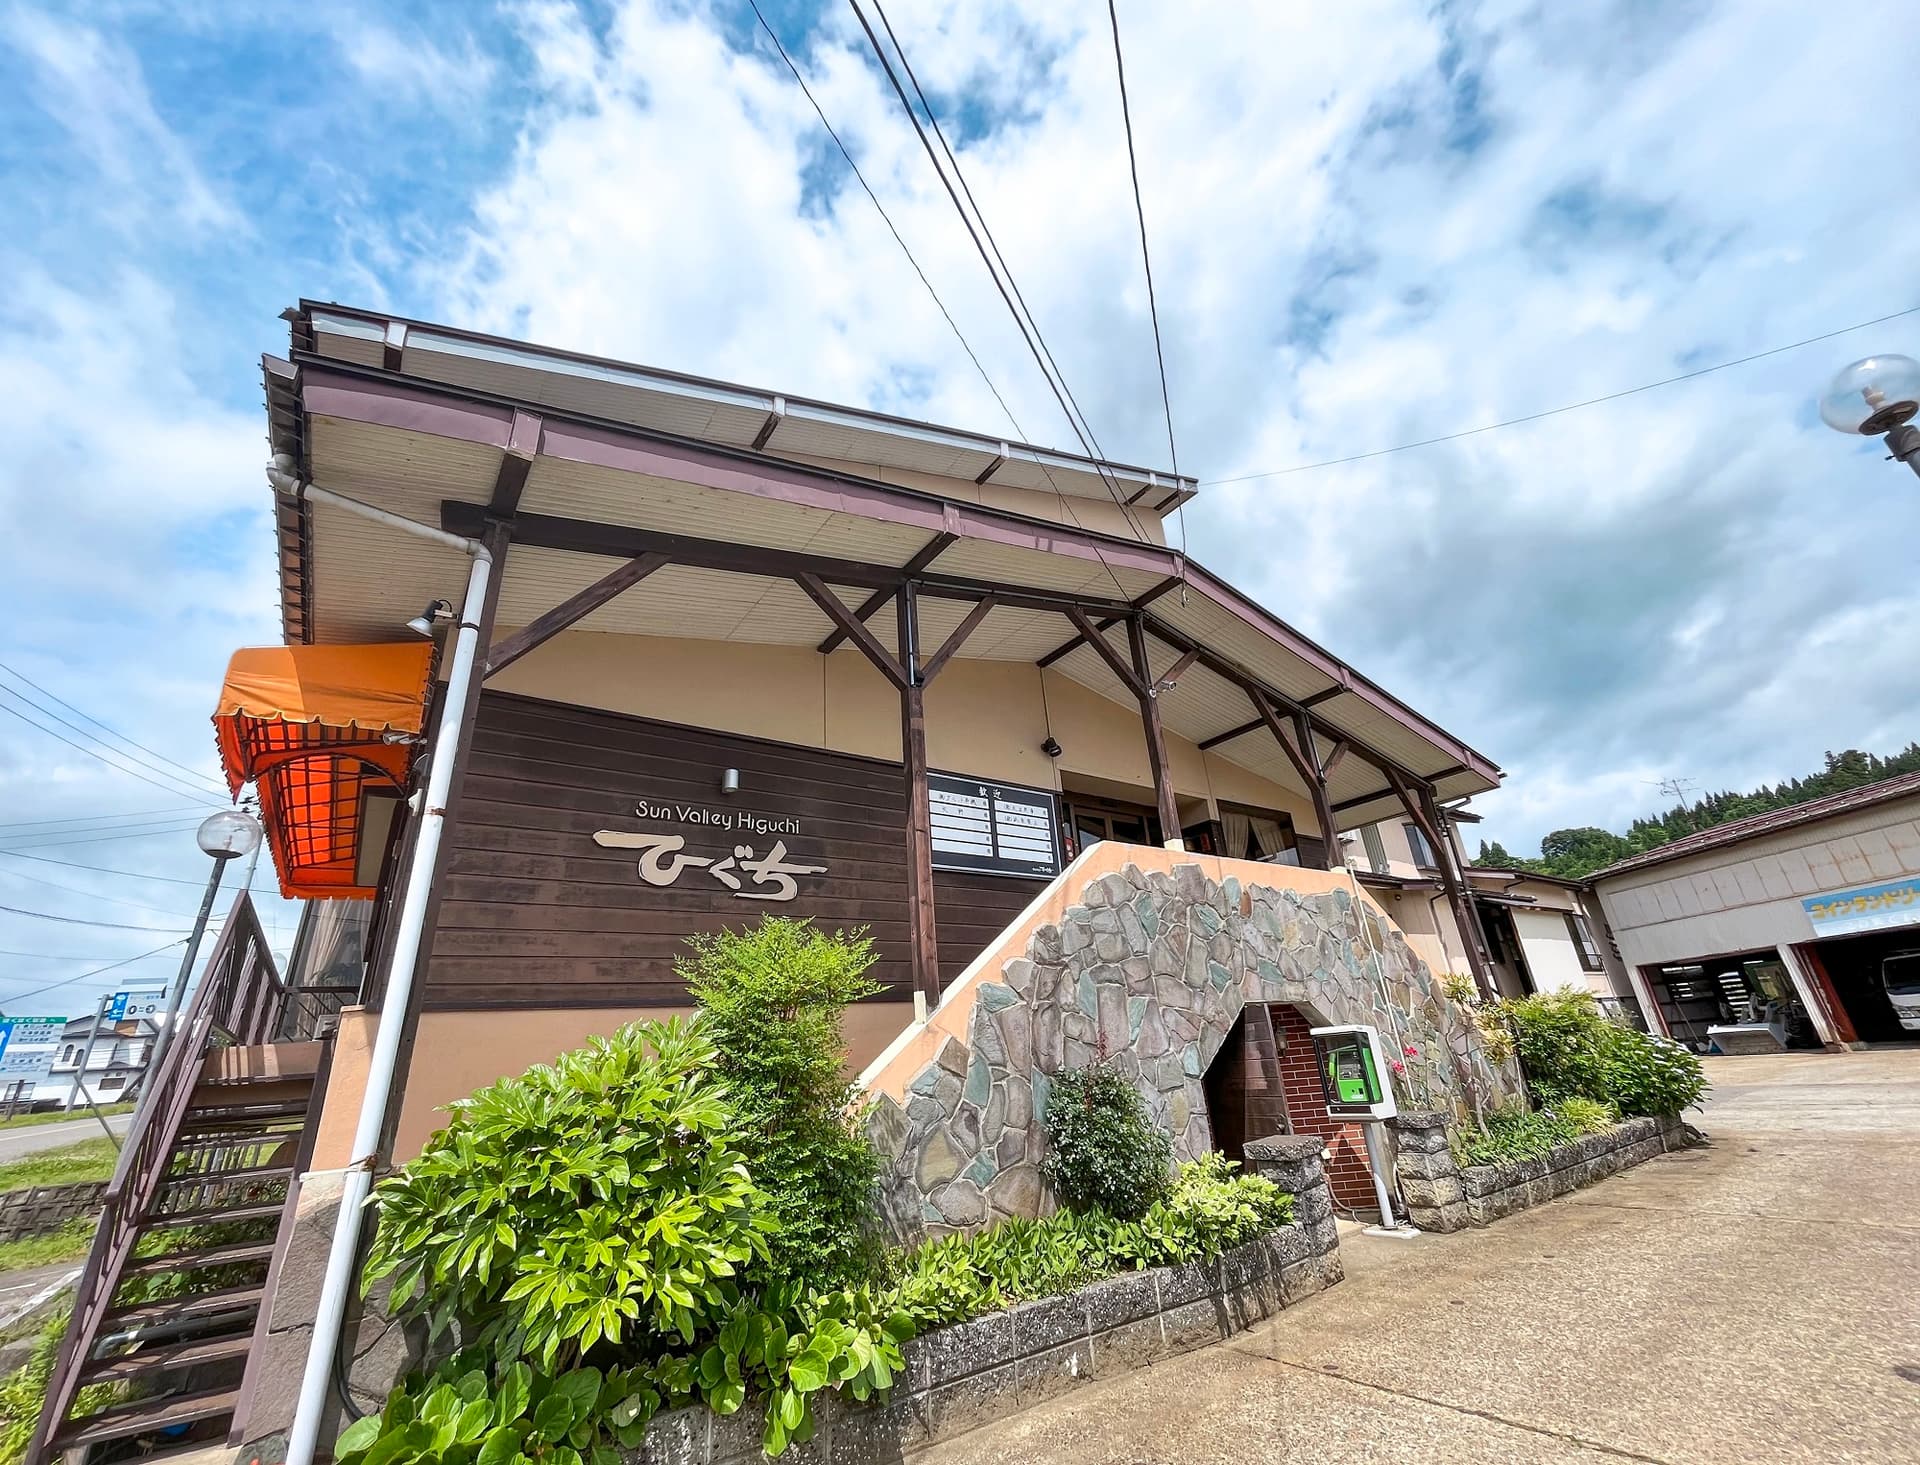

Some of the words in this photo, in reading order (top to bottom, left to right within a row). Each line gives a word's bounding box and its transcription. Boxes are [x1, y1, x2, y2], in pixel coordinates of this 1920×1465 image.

[636, 801, 671, 819] Sun
[677, 805, 733, 830] Valley
[738, 812, 800, 834] Higuchi
[593, 830, 828, 901] ひぐち
